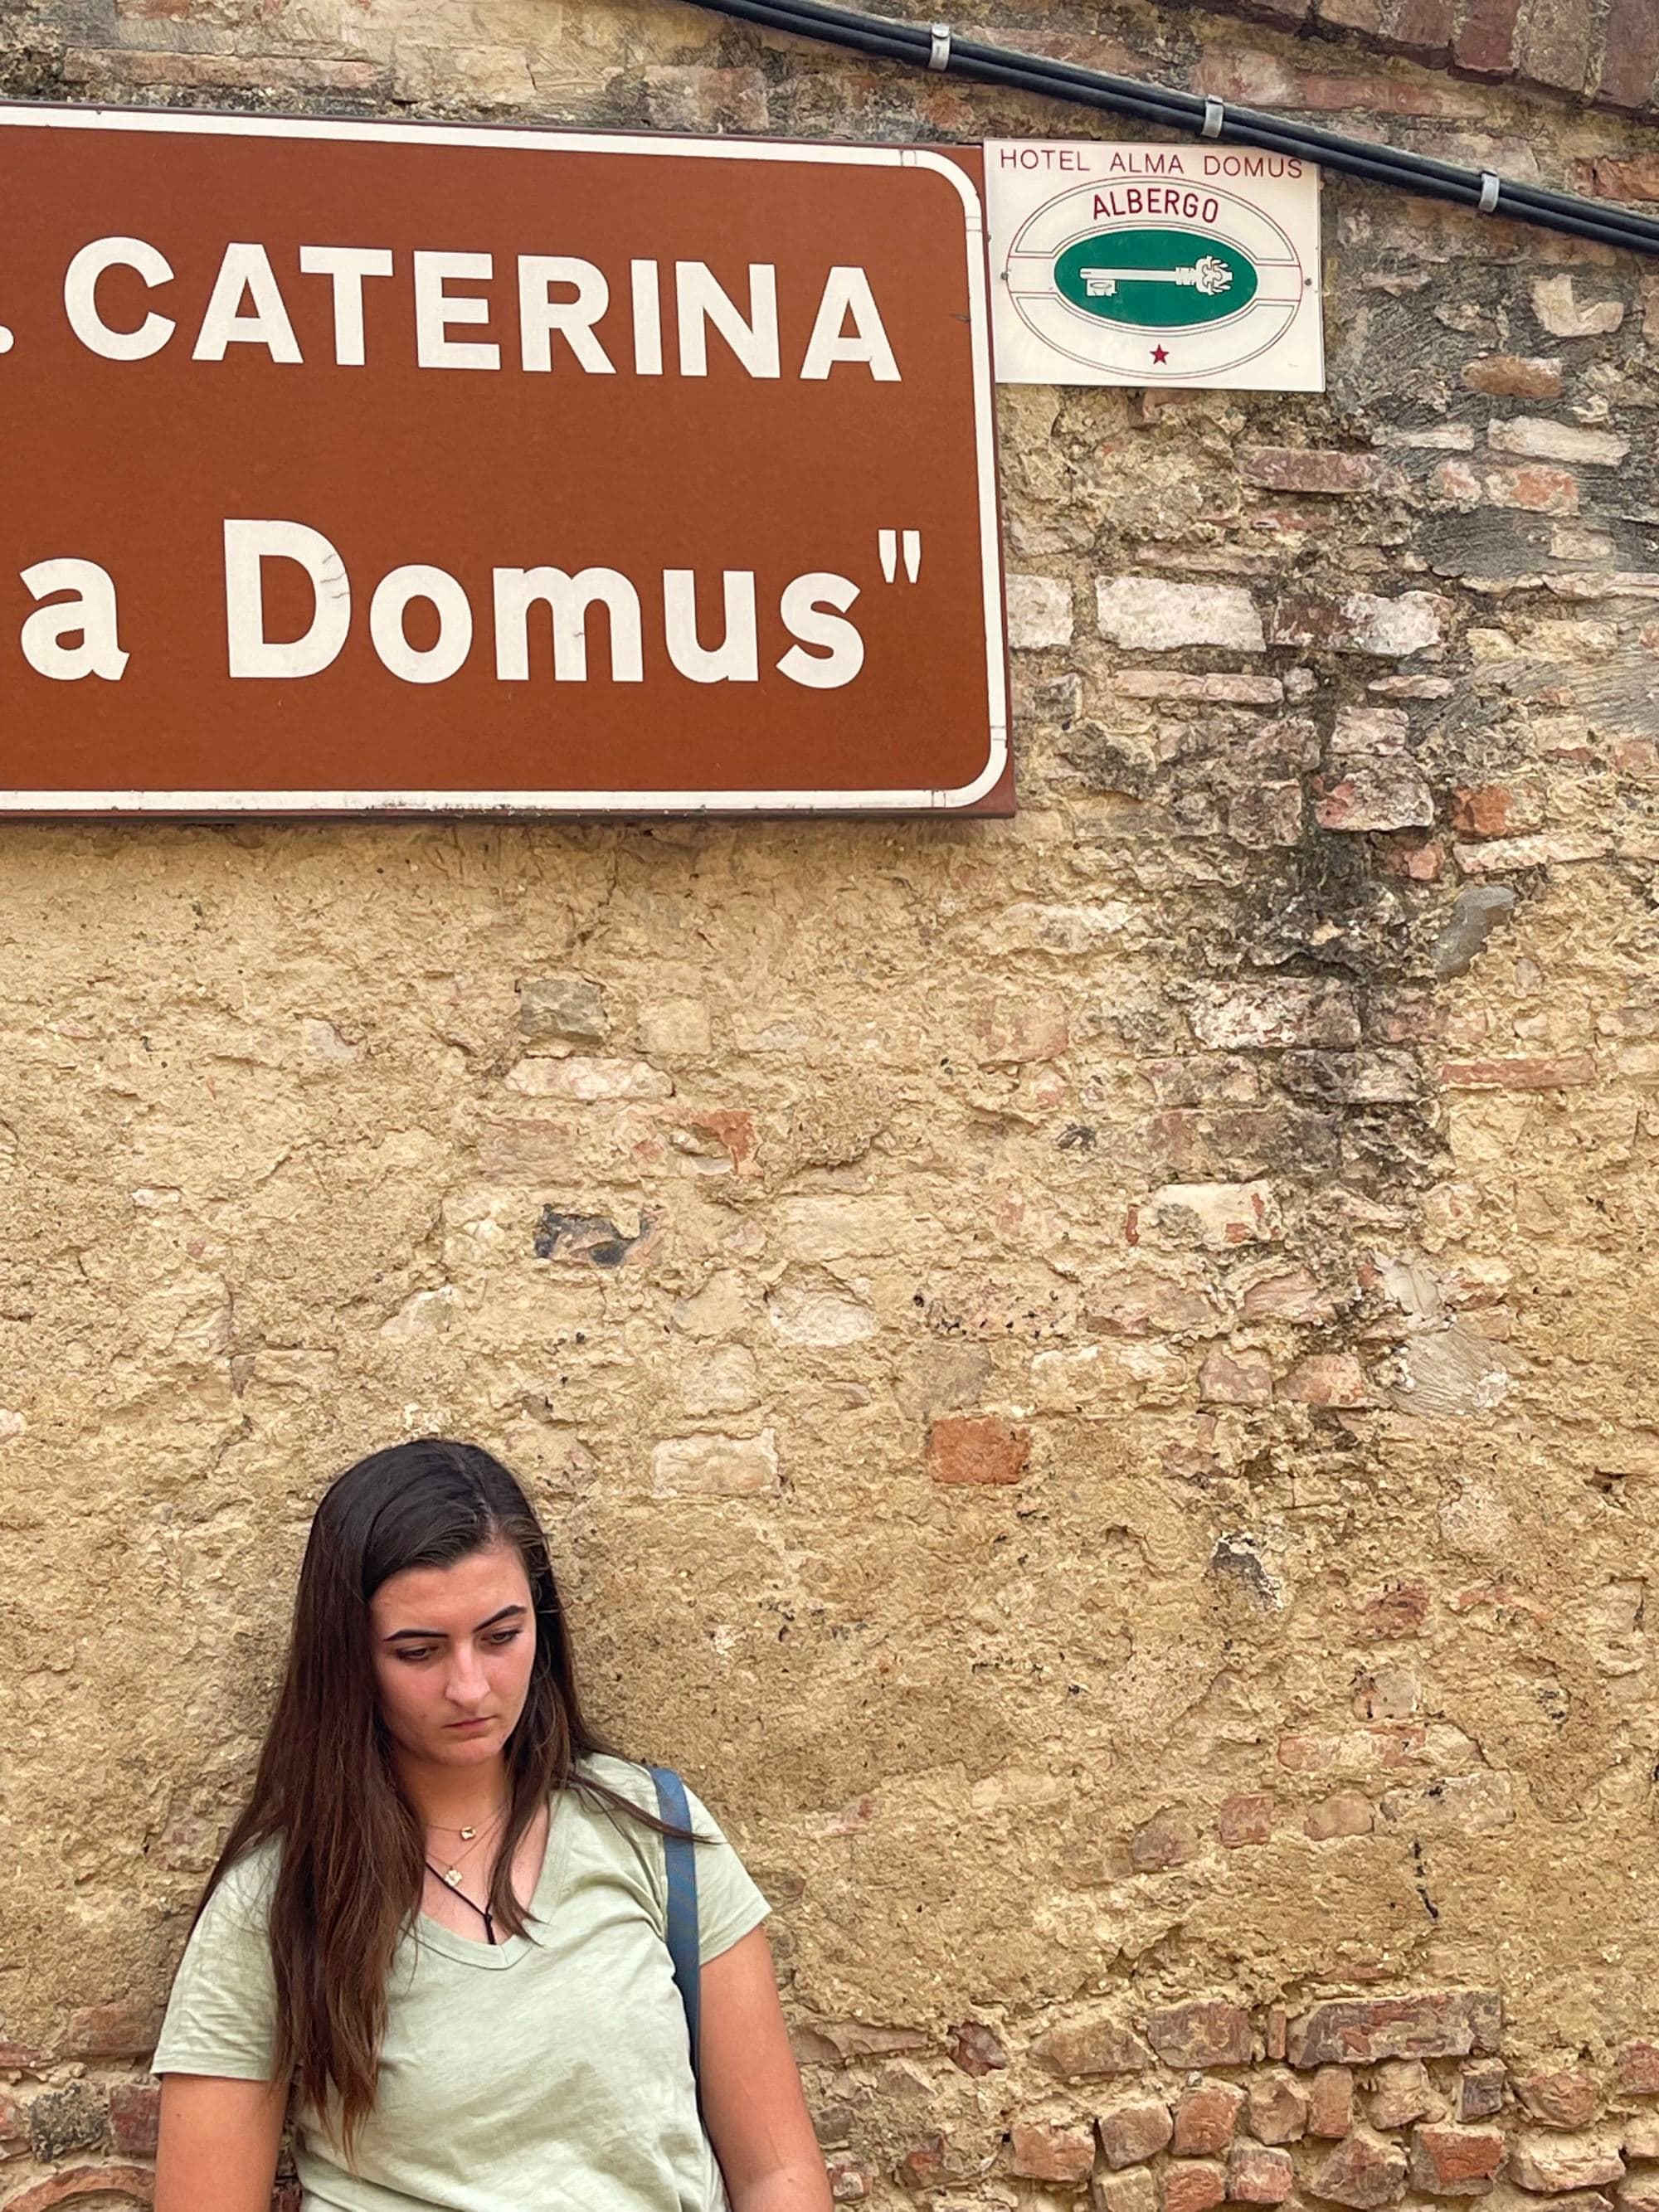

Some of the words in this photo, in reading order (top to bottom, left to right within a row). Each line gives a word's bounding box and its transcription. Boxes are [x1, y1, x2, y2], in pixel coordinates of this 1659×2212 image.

[1000, 148, 1090, 171] HOTEL
[1109, 153, 1185, 174] ALMA
[1204, 155, 1302, 178] DOMUS
[1092, 187, 1219, 224] ALBERGO
[64, 236, 902, 382] CATERINA
[224, 519, 921, 688] Domus"
